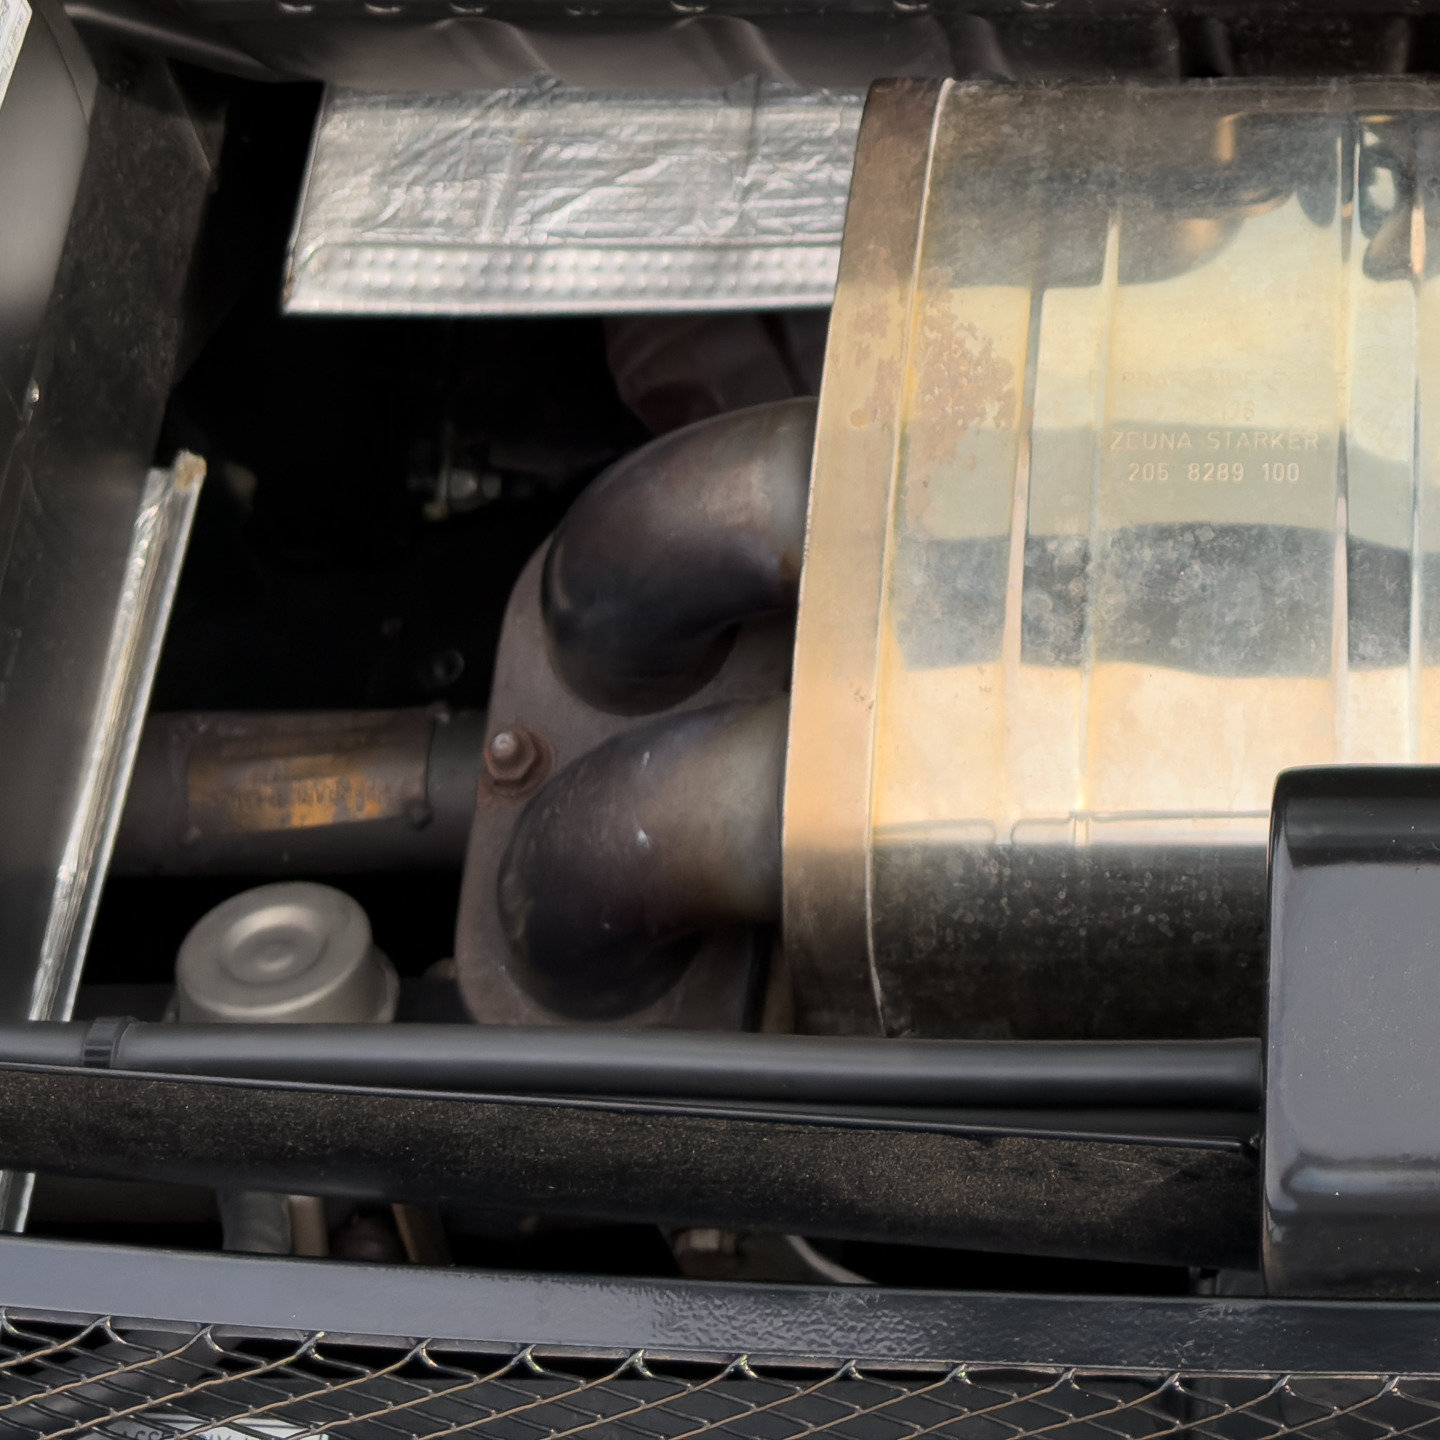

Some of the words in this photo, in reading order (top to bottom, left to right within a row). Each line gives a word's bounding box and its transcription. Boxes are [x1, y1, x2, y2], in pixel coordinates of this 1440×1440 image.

[1110, 430, 1193, 451] ZEUNA
[1127, 461, 1170, 483] 205
[1186, 461, 1246, 483] 8289
[1261, 461, 1301, 483] 100
